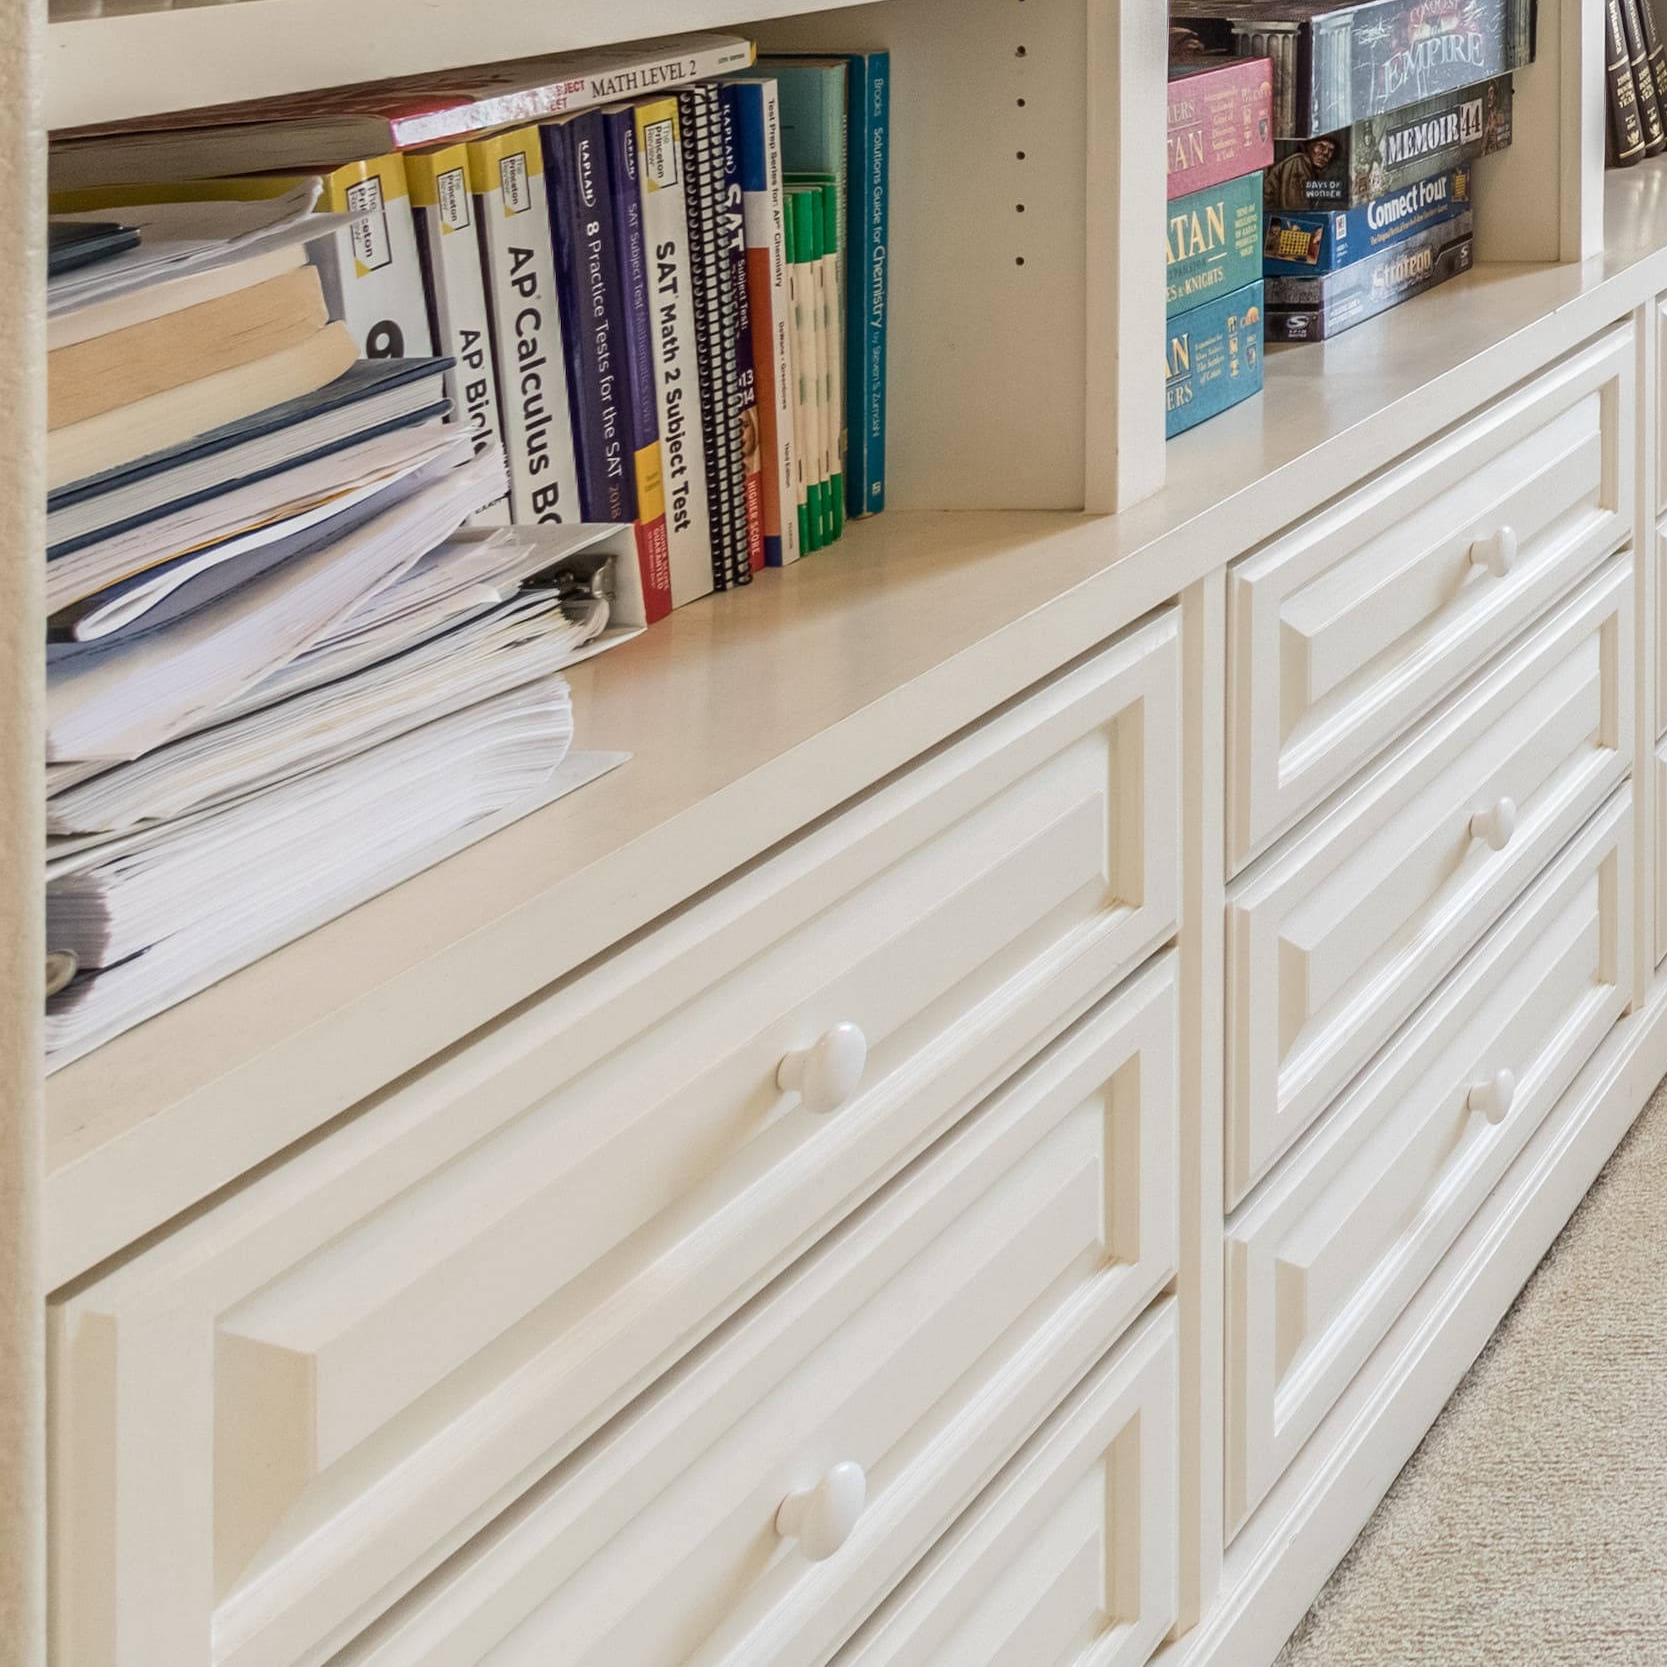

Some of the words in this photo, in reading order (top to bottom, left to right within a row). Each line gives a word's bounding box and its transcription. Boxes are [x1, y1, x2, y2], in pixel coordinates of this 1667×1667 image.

[591, 70, 639, 99] MATH
[641, 62, 686, 88] LEVEL
[689, 60, 697, 76] 2
[1377, 32, 1485, 103] EMPIRE
[1386, 111, 1460, 166] MEMOIR
[586, 220, 601, 237] 8
[1367, 190, 1419, 230] Connect
[1419, 176, 1447, 208] Four
[507, 246, 538, 299] AP
[588, 239, 606, 319] Practice
[656, 240, 676, 291] SAT
[595, 320, 611, 378] Tests
[658, 302, 681, 365] Math
[514, 308, 550, 477] Calculus
[599, 379, 613, 407] for
[663, 367, 682, 387] 2
[602, 408, 617, 440] the
[664, 389, 687, 477] Subject
[605, 441, 622, 479] SAT
[672, 481, 692, 534] Test
